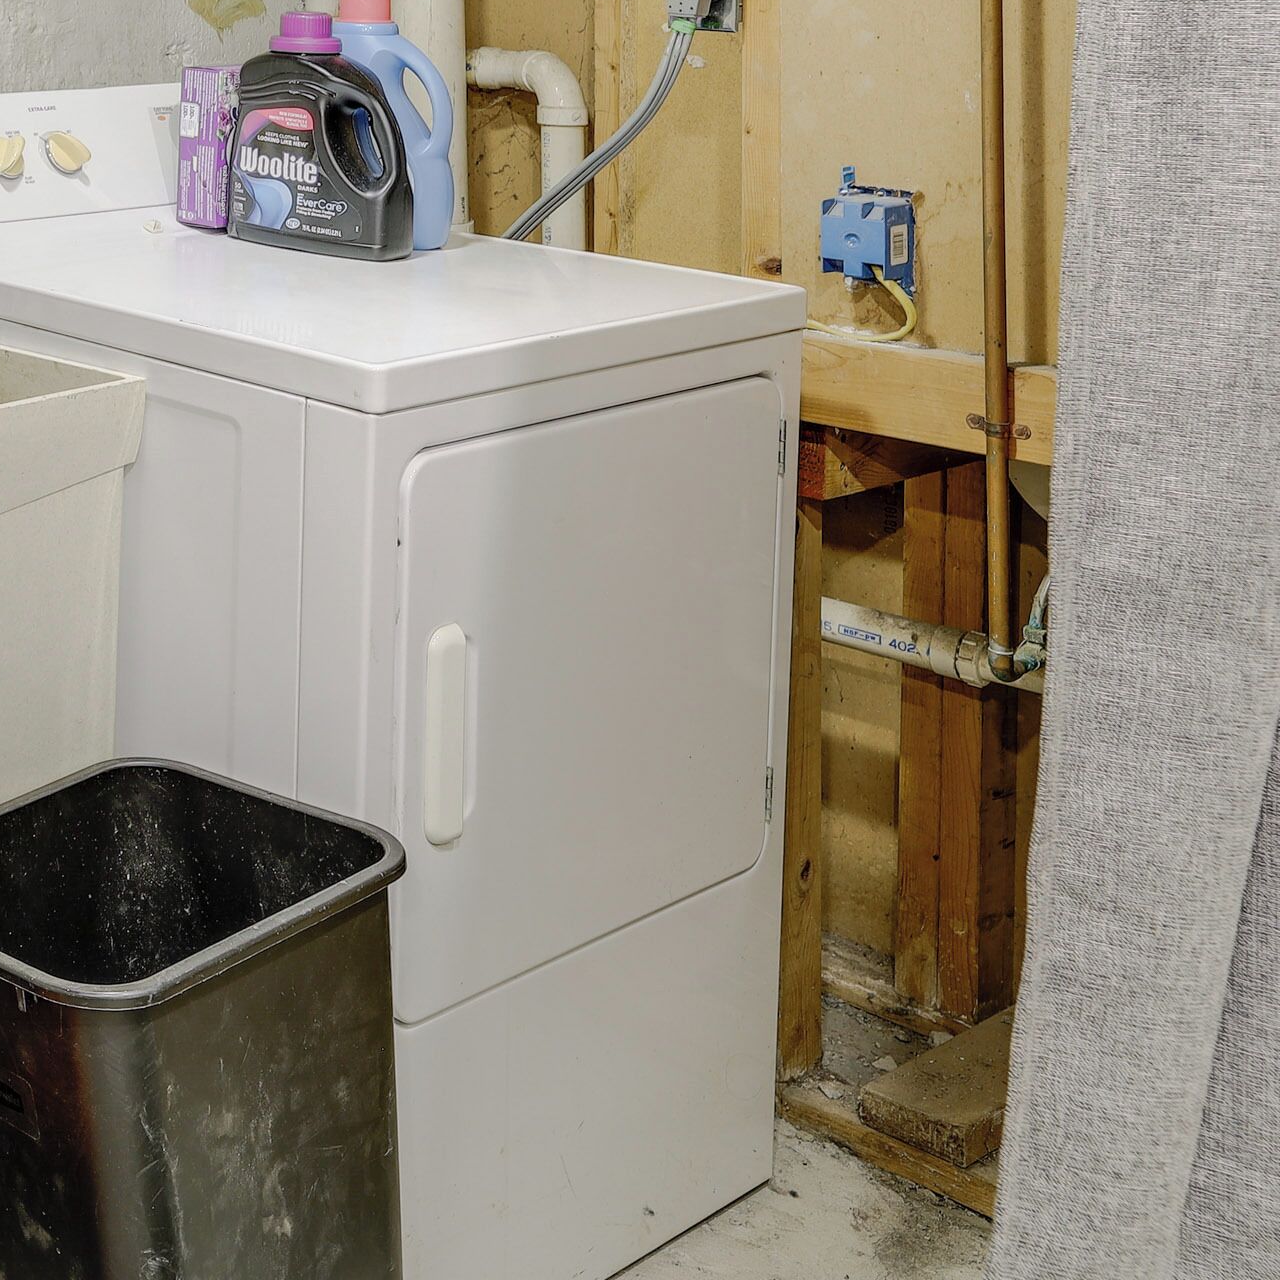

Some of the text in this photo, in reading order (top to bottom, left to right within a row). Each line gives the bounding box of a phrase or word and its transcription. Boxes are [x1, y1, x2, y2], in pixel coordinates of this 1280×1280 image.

[256, 134, 280, 145] LOOKING
[280, 138, 293, 146] LIKE
[240, 146, 318, 184] Woolite
[297, 184, 318, 194] DARKS
[296, 194, 343, 213] EverCare
